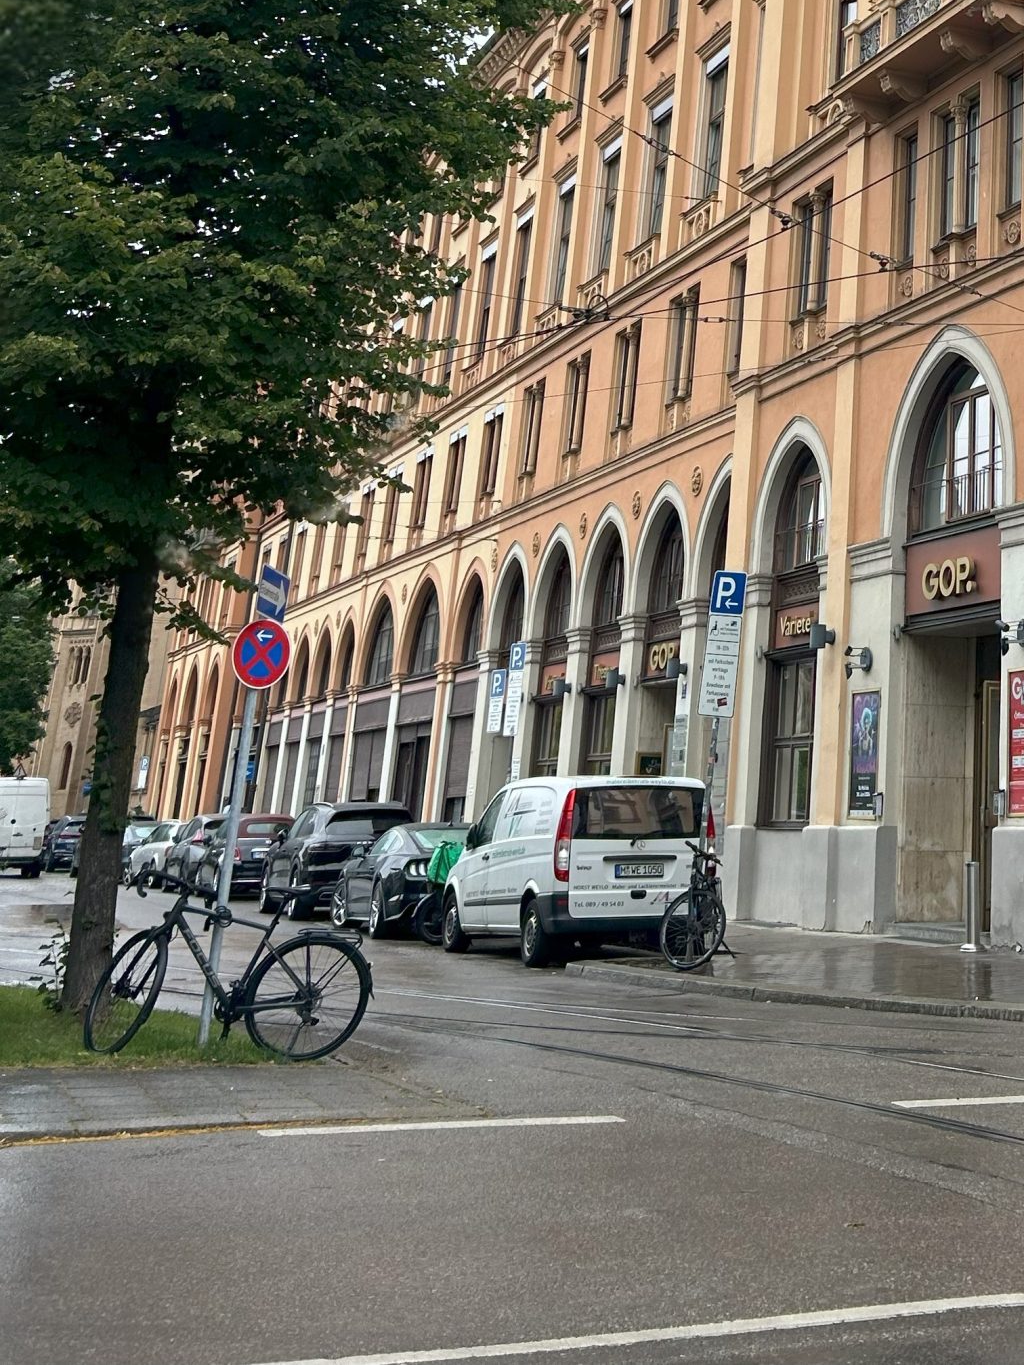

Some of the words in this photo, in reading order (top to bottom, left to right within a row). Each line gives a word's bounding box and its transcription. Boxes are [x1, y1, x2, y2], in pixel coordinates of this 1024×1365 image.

[716, 577, 736, 609] P
[512, 647, 522, 668] P
[493, 674, 502, 694] P
